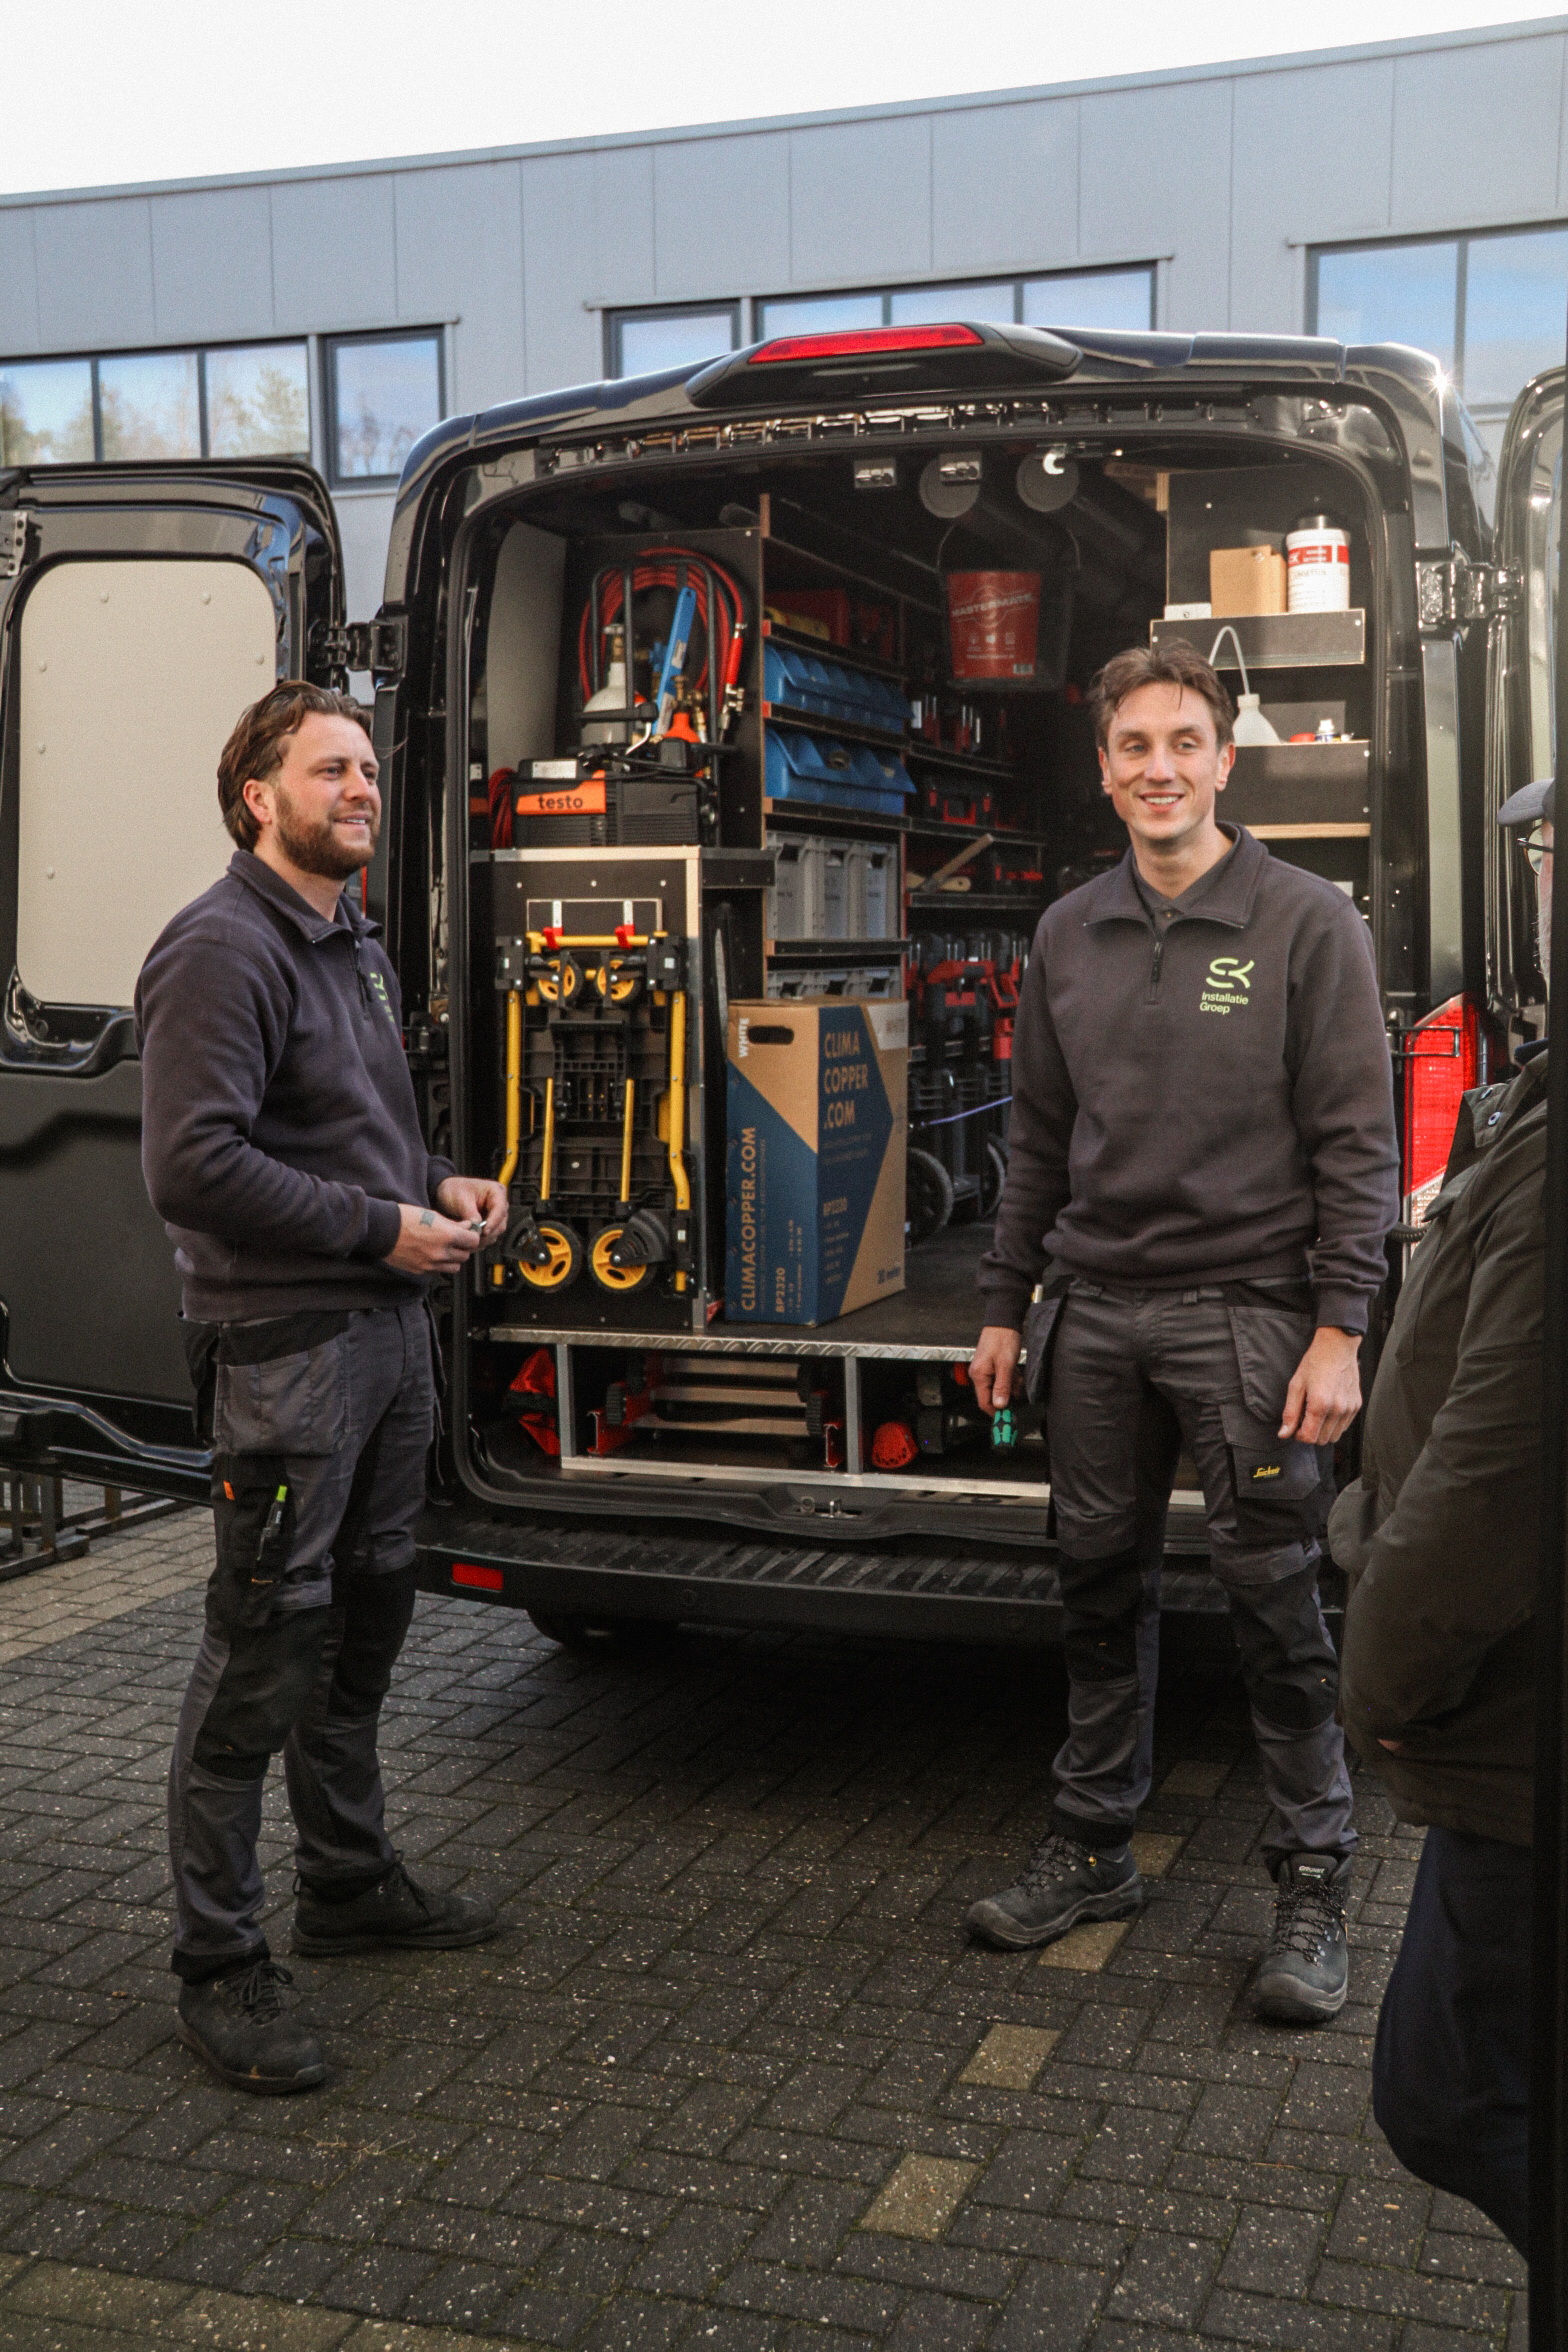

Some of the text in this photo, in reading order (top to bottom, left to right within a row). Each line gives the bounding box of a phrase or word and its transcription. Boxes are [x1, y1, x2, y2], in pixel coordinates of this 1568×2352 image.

[538, 795, 583, 809] testo
[1200, 1001, 1231, 1015] Groep
[1201, 991, 1249, 1005] Installatie
[739, 1018, 750, 1058] WHITE
[824, 1031, 860, 1058] CLIMA
[824, 1064, 869, 1094] COPPER
[824, 1099, 856, 1130] .COM
[740, 1127, 756, 1311] CLIMACOPPER.COM
[775, 1267, 786, 1313] BP2320
